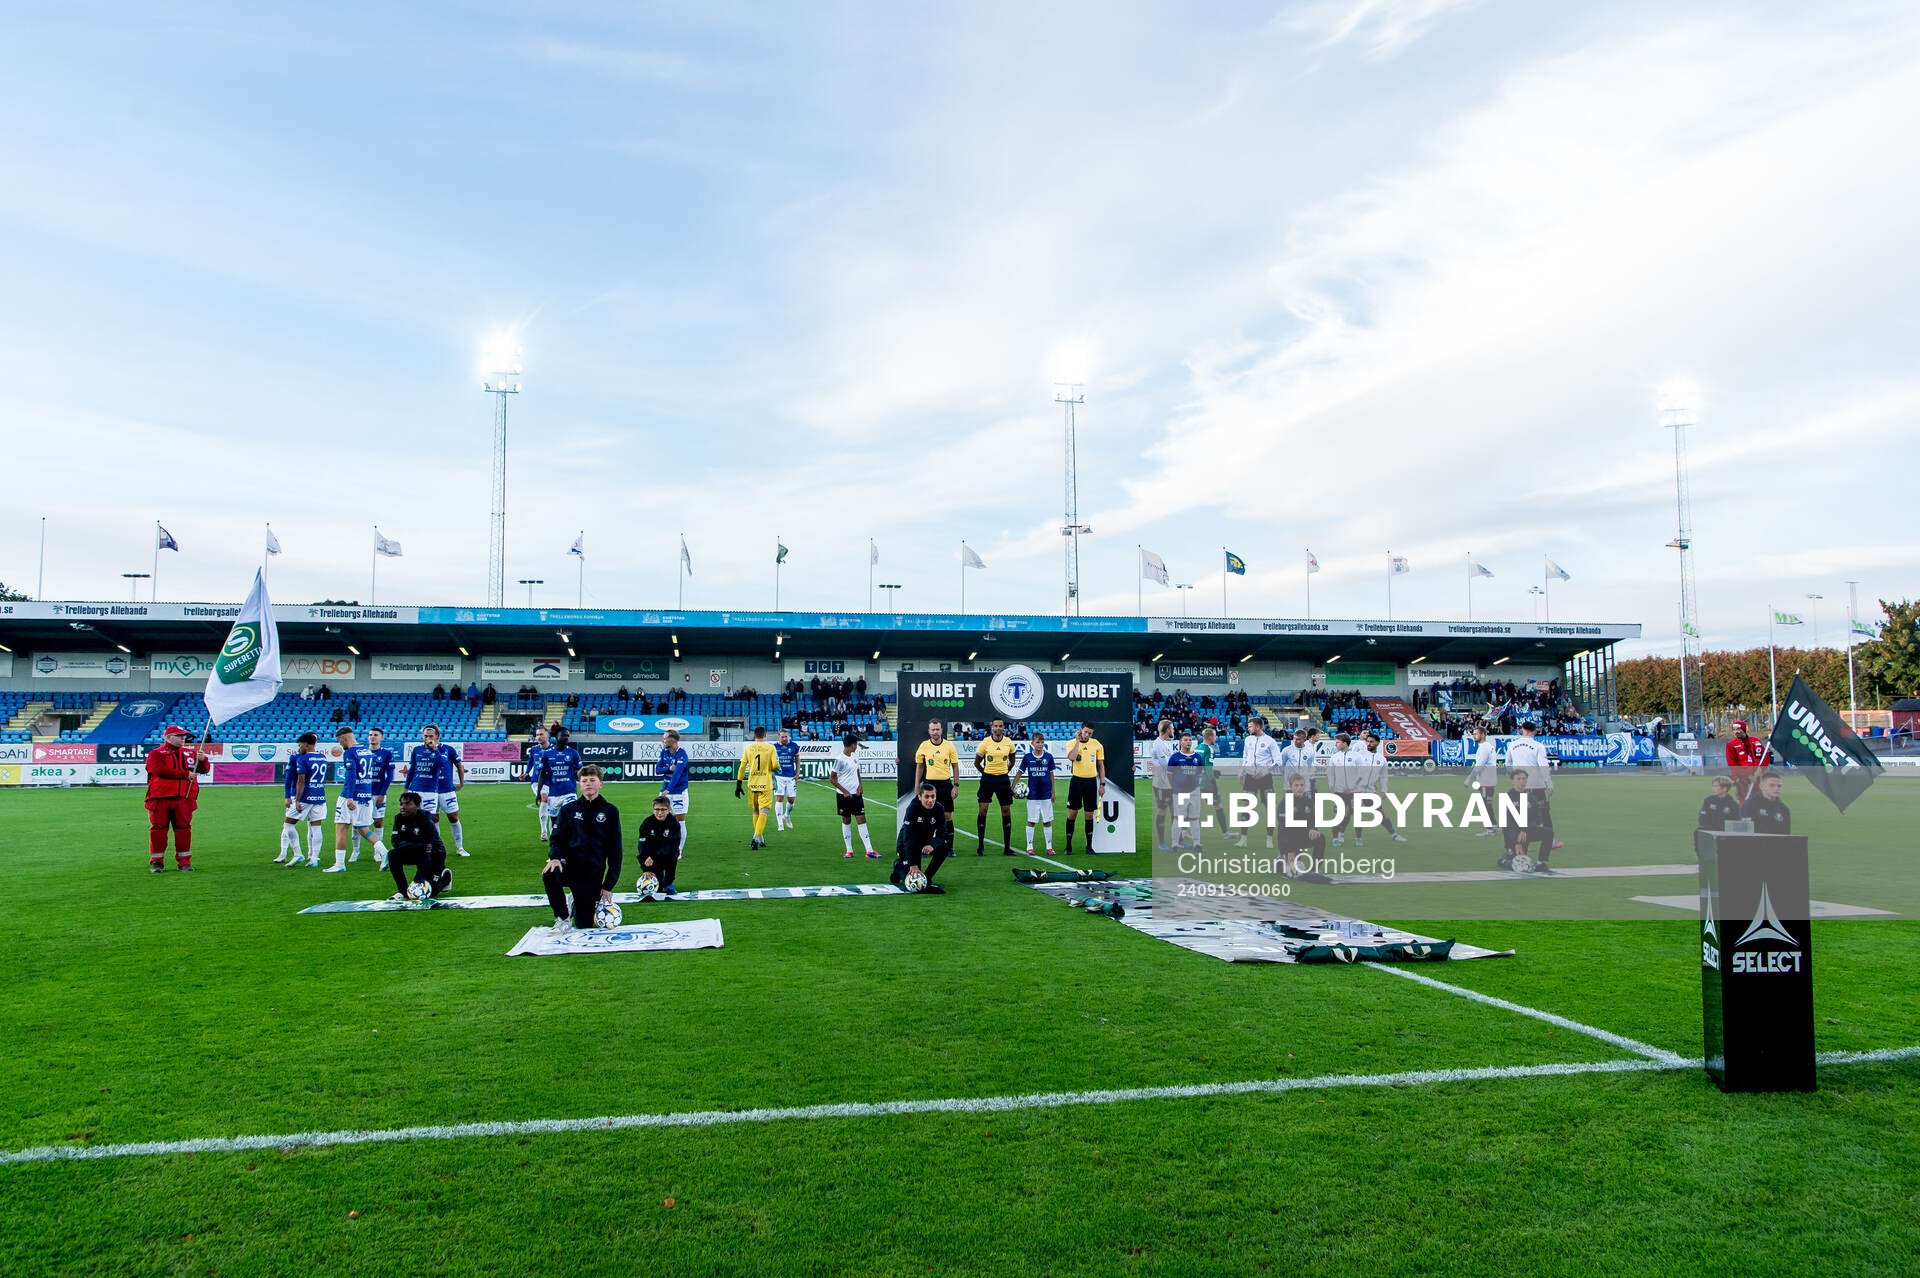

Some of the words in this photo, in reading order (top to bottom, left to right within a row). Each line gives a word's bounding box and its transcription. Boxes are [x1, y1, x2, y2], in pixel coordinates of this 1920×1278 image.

[65, 606, 109, 617] Trelleborgs
[110, 606, 148, 616] Allehanda
[184, 607, 241, 618] trelleborgsalle
[320, 608, 361, 619] Trelleborgs
[362, 609, 398, 619] Allehanda
[1174, 621, 1207, 631] Trelleborgs
[1208, 621, 1236, 630] Allehanda
[1263, 622, 1329, 632] trelleborgsallehanda.se
[1364, 624, 1396, 634] Trelleborgs
[1397, 624, 1423, 633] Allehanda
[1448, 625, 1512, 635] trelleborgsallehanda.se
[1545, 626, 1576, 636] Trelleborgs
[1576, 626, 1602, 635] Allehanda
[223, 647, 263, 673] SUPERETTA
[283, 657, 352, 674] ARABO
[389, 663, 424, 673] Trelleborgs
[424, 663, 455, 671] Allehanda
[1172, 666, 1198, 677] ALDRIG
[1199, 666, 1224, 677] ENSAM
[1418, 669, 1449, 679] Trelleborgs
[911, 683, 977, 698] UNIBET
[1056, 684, 1121, 699] UNIBET
[1787, 700, 1861, 776] UNIBET
[49, 748, 95, 756] SMARTARE
[582, 747, 619, 755] CRAFT
[640, 750, 661, 758] JACO
[692, 750, 736, 758] JACOBSON
[359, 757, 374, 779] 34
[754, 753, 761, 772] 1
[31, 767, 62, 777] akea
[96, 767, 127, 776] akea
[310, 763, 328, 783] 29
[799, 762, 833, 777] ETTAN
[859, 763, 897, 774] ELLBY
[1102, 800, 1120, 823] U
[1732, 951, 1802, 974] SELECT
